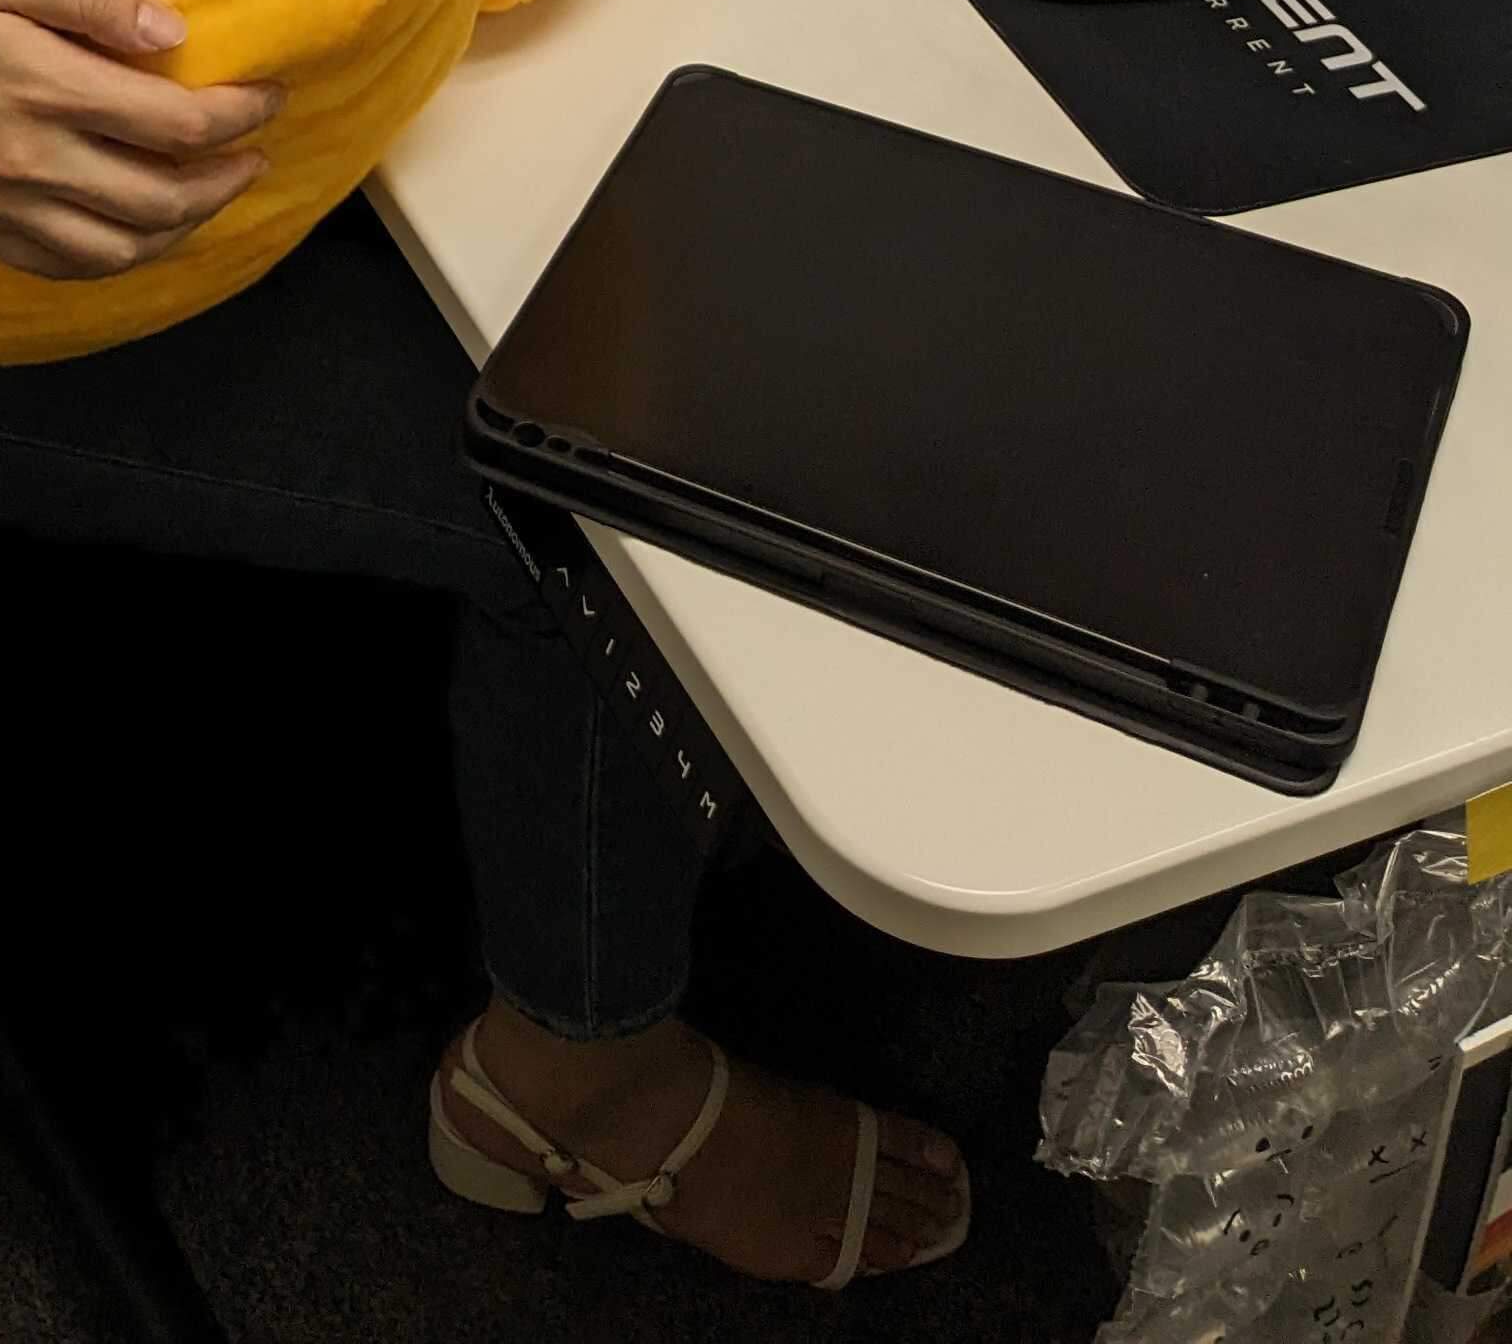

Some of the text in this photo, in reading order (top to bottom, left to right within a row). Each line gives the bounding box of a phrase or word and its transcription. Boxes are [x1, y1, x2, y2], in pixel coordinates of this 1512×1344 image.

[626, 672, 640, 699] 2
[649, 710, 664, 737] 3
[677, 750, 691, 779] 4
[700, 791, 717, 819] M
